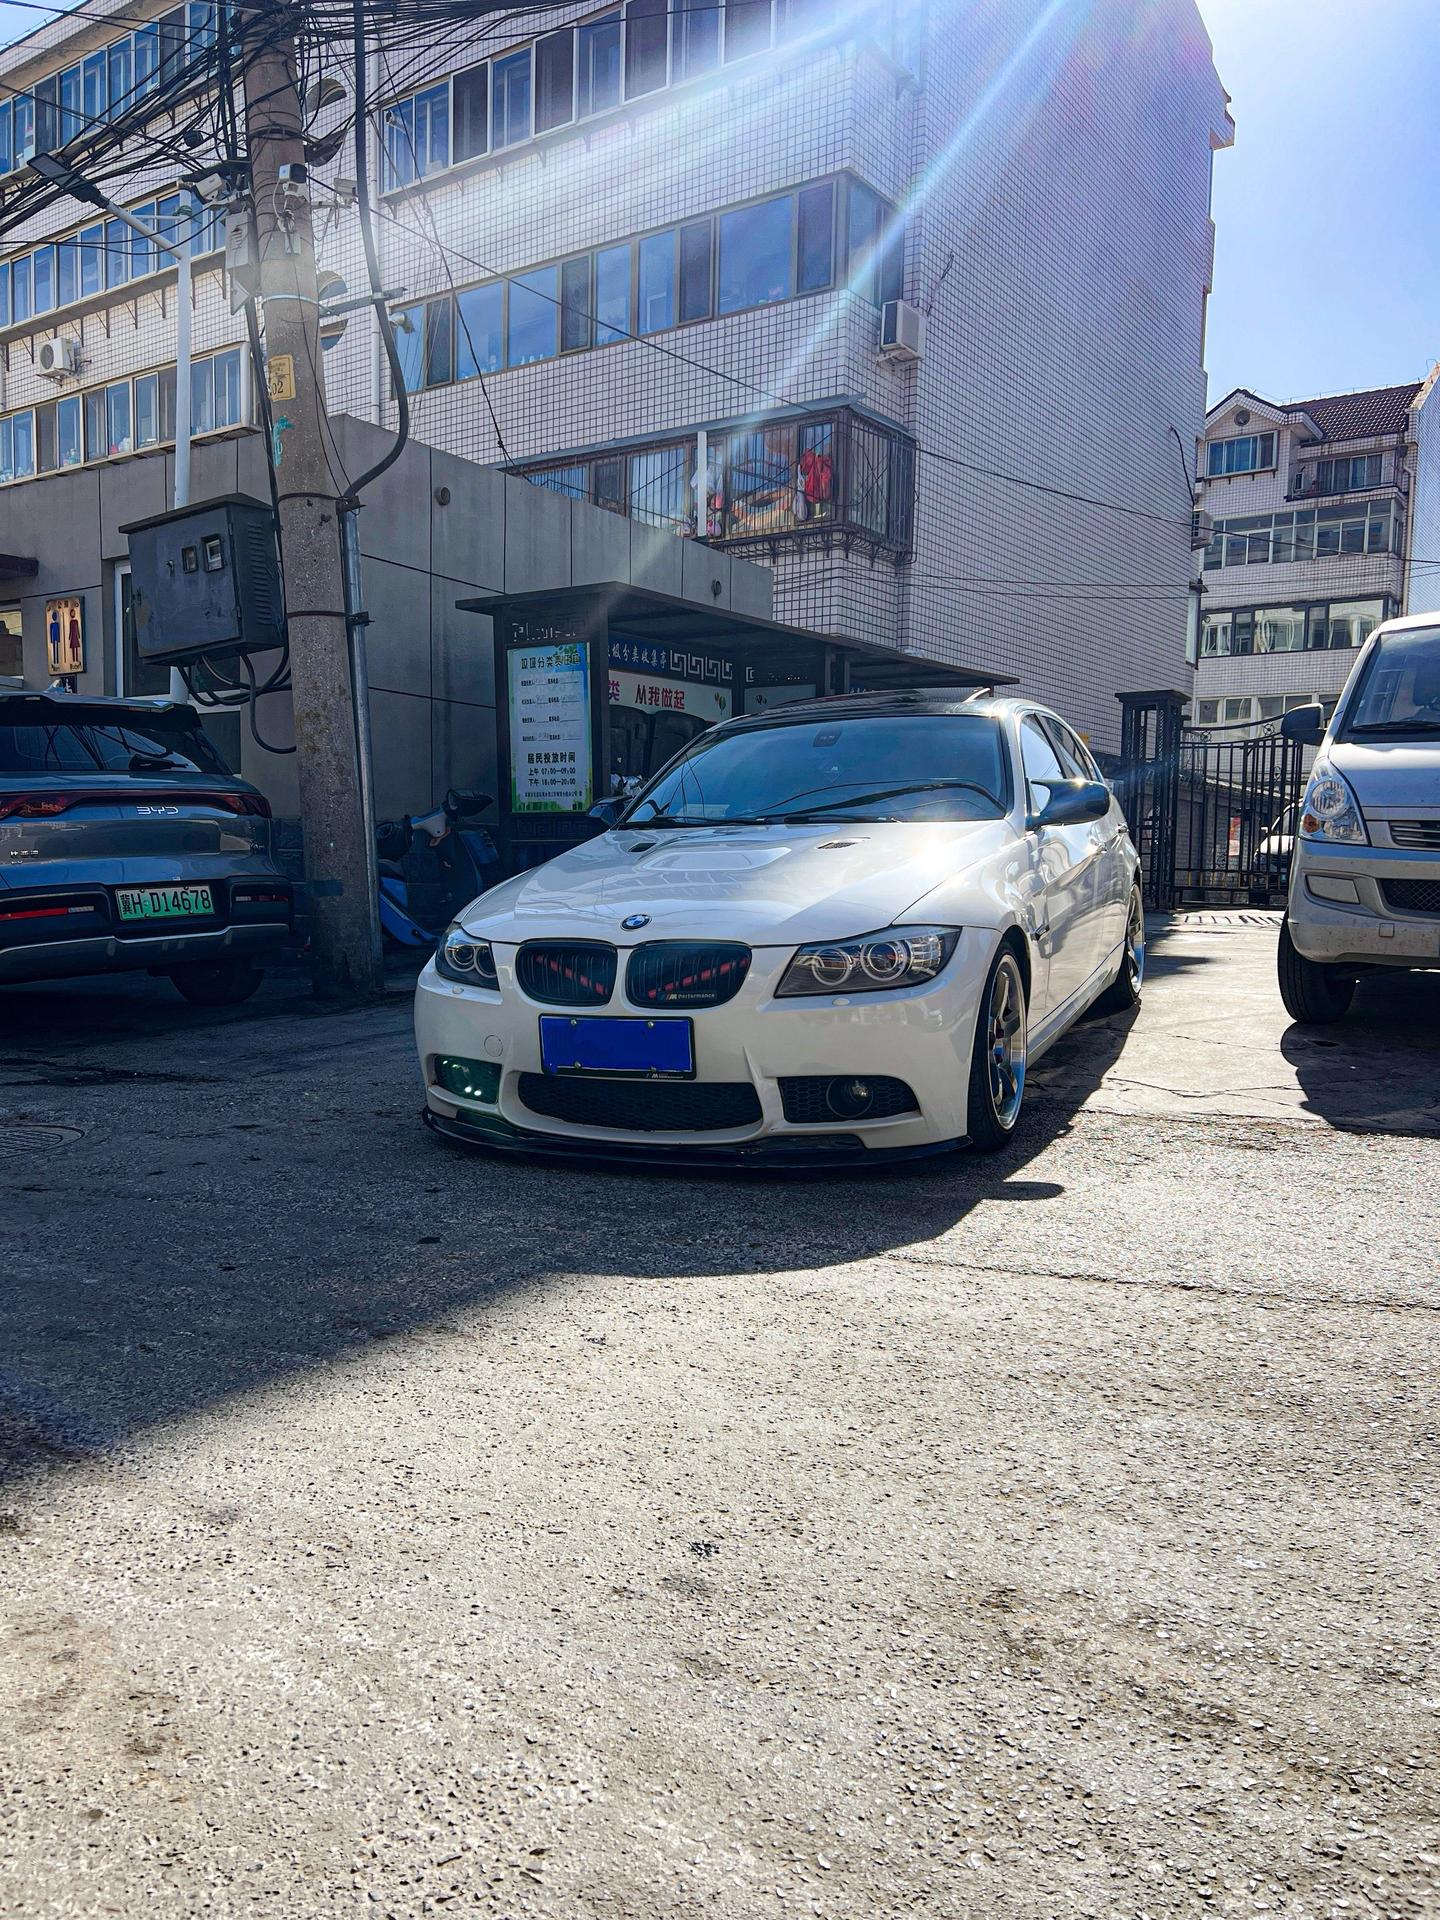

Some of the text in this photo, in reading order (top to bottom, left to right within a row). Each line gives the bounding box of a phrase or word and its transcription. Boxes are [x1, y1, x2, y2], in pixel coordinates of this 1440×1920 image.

[607, 642, 667, 669] 圾分类收集亭
[635, 684, 685, 710] 从我做起
[527, 752, 576, 764] 居民投放时间
[528, 768, 540, 776] 上午
[528, 779, 540, 787] 下午
[136, 806, 179, 815] BYD
